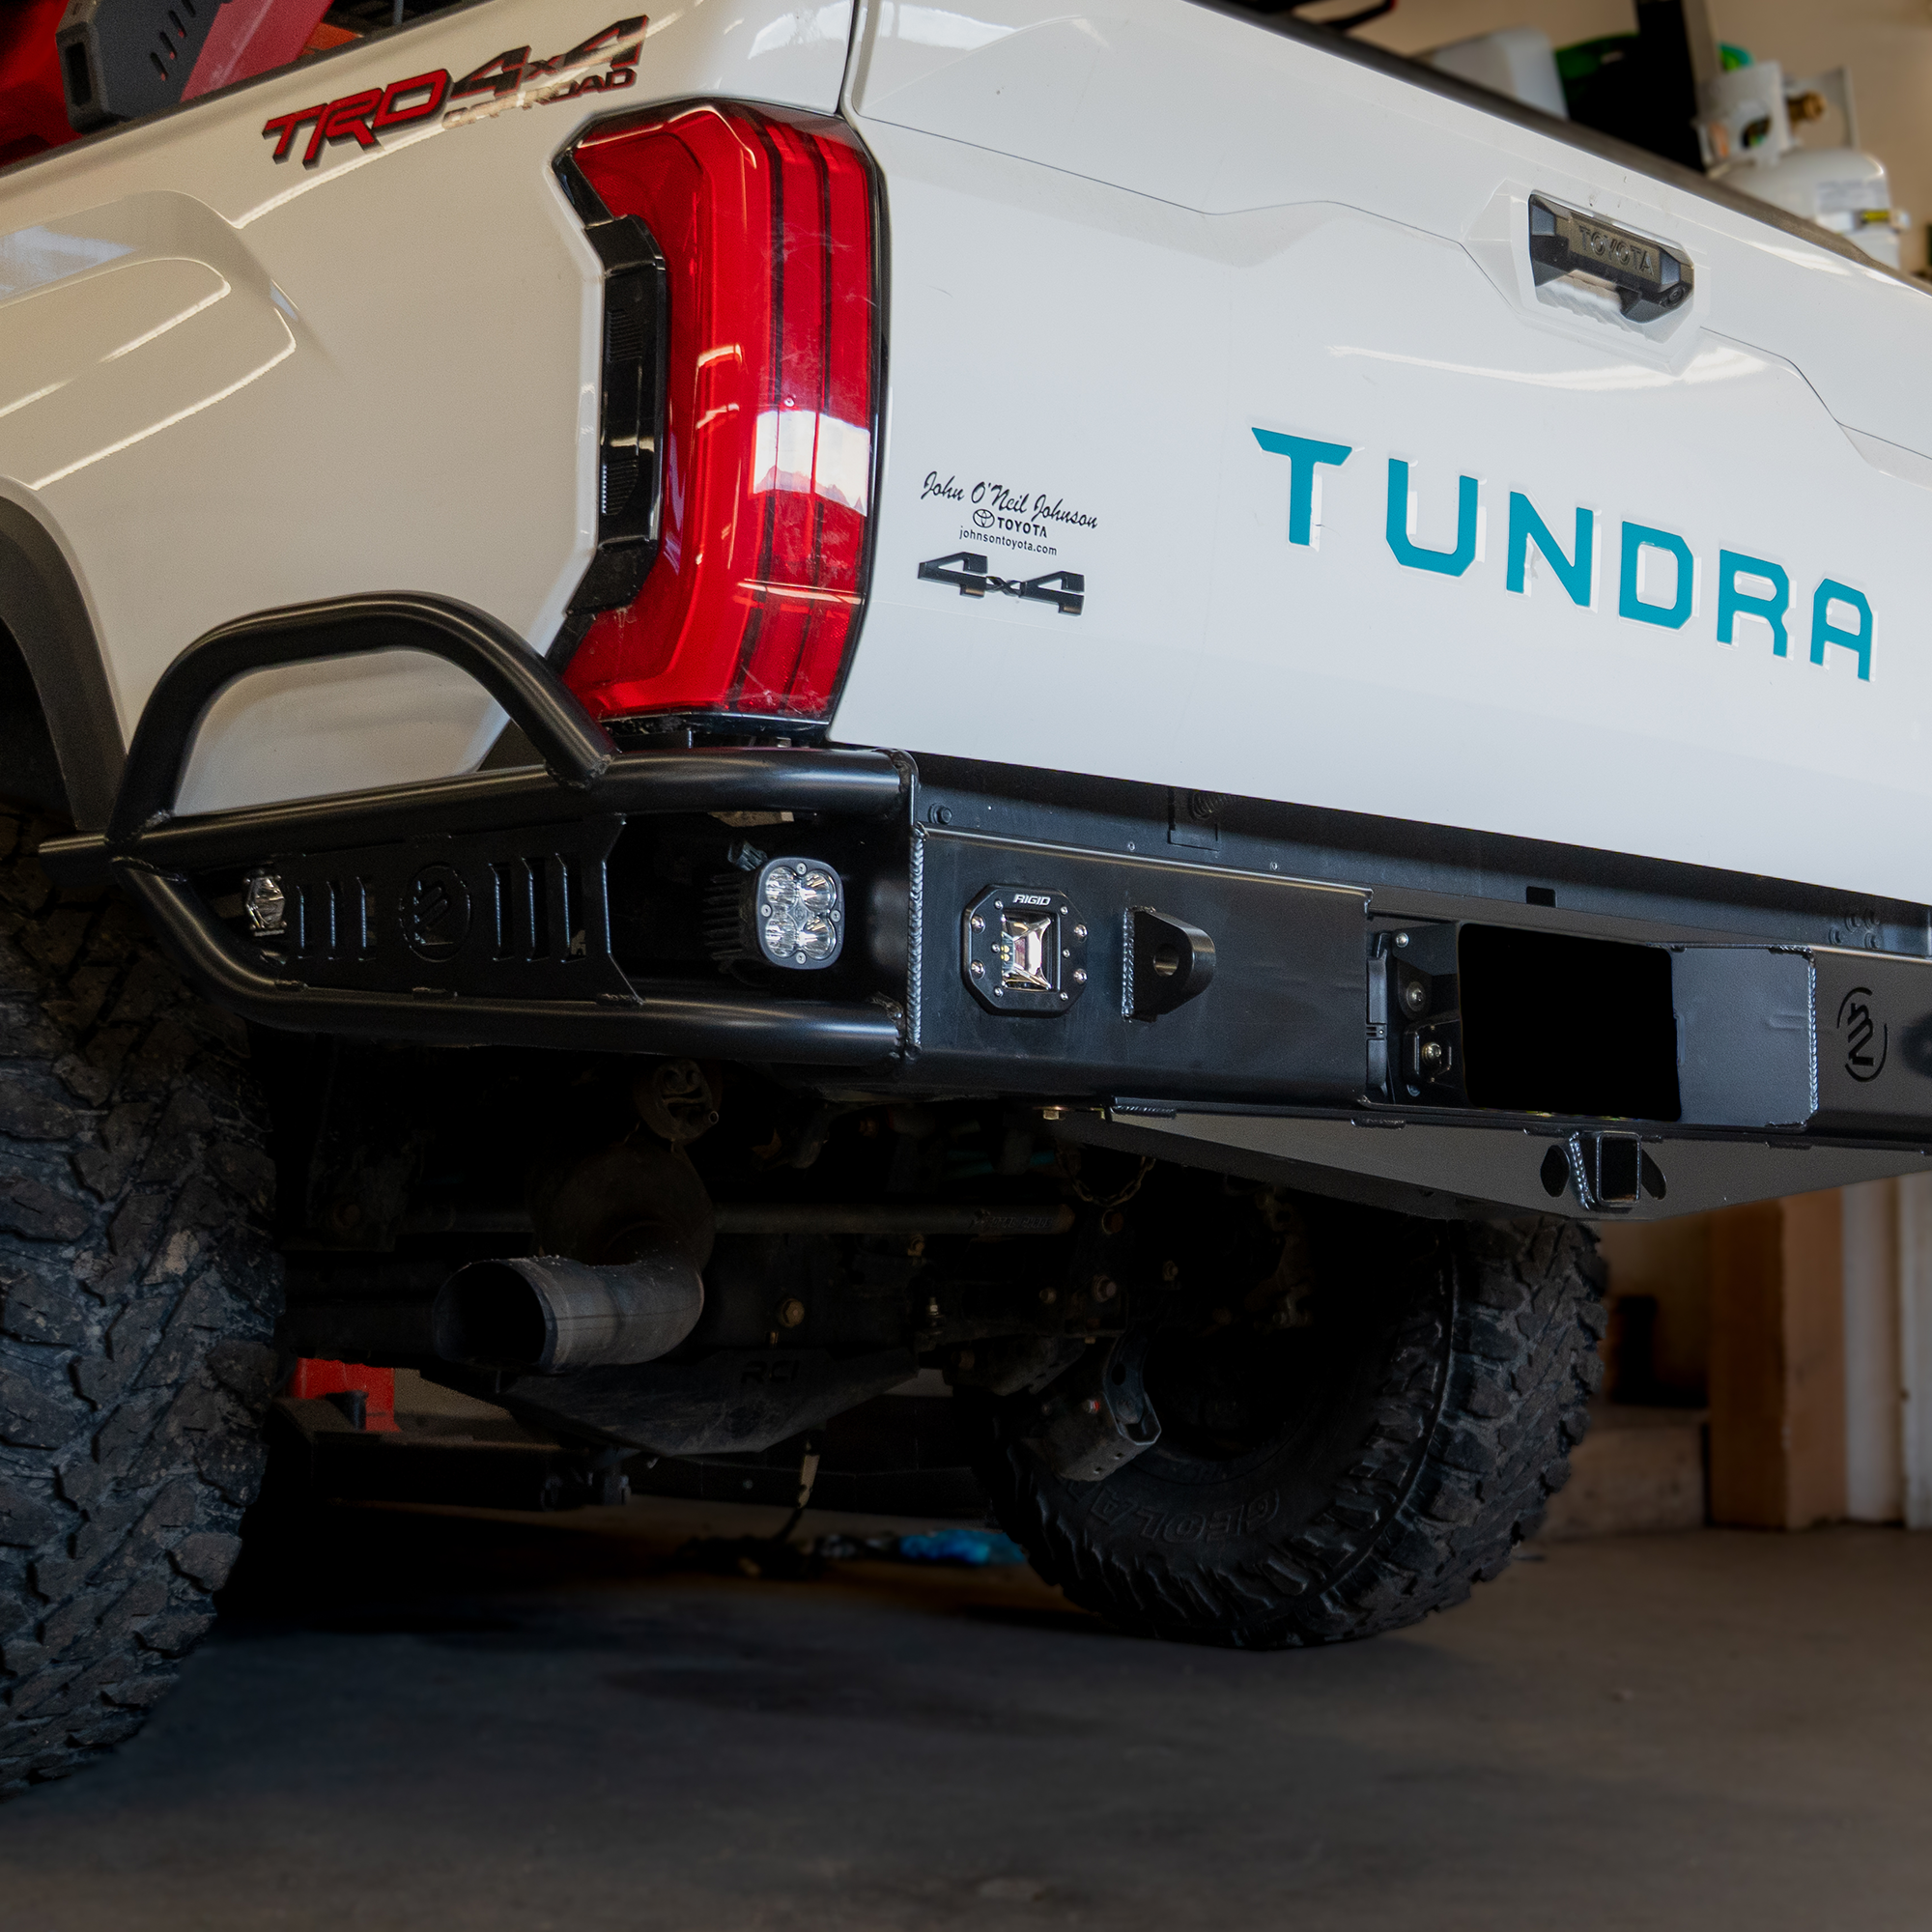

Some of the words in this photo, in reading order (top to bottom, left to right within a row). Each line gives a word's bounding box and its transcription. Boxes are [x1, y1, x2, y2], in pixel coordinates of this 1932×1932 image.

[261, 69, 452, 170] TRD
[1578, 225, 1655, 276] TOYOTA
[921, 470, 965, 501] John
[970, 481, 1030, 513] O'Neil
[1031, 494, 1098, 529] Johnson
[959, 526, 1058, 555] johnsontoyota.com
[997, 517, 1048, 538] TOYOTA
[1251, 426, 1872, 682] TUNDRA
[1012, 894, 1051, 906] RIGID
[740, 1359, 800, 1383] RCI
